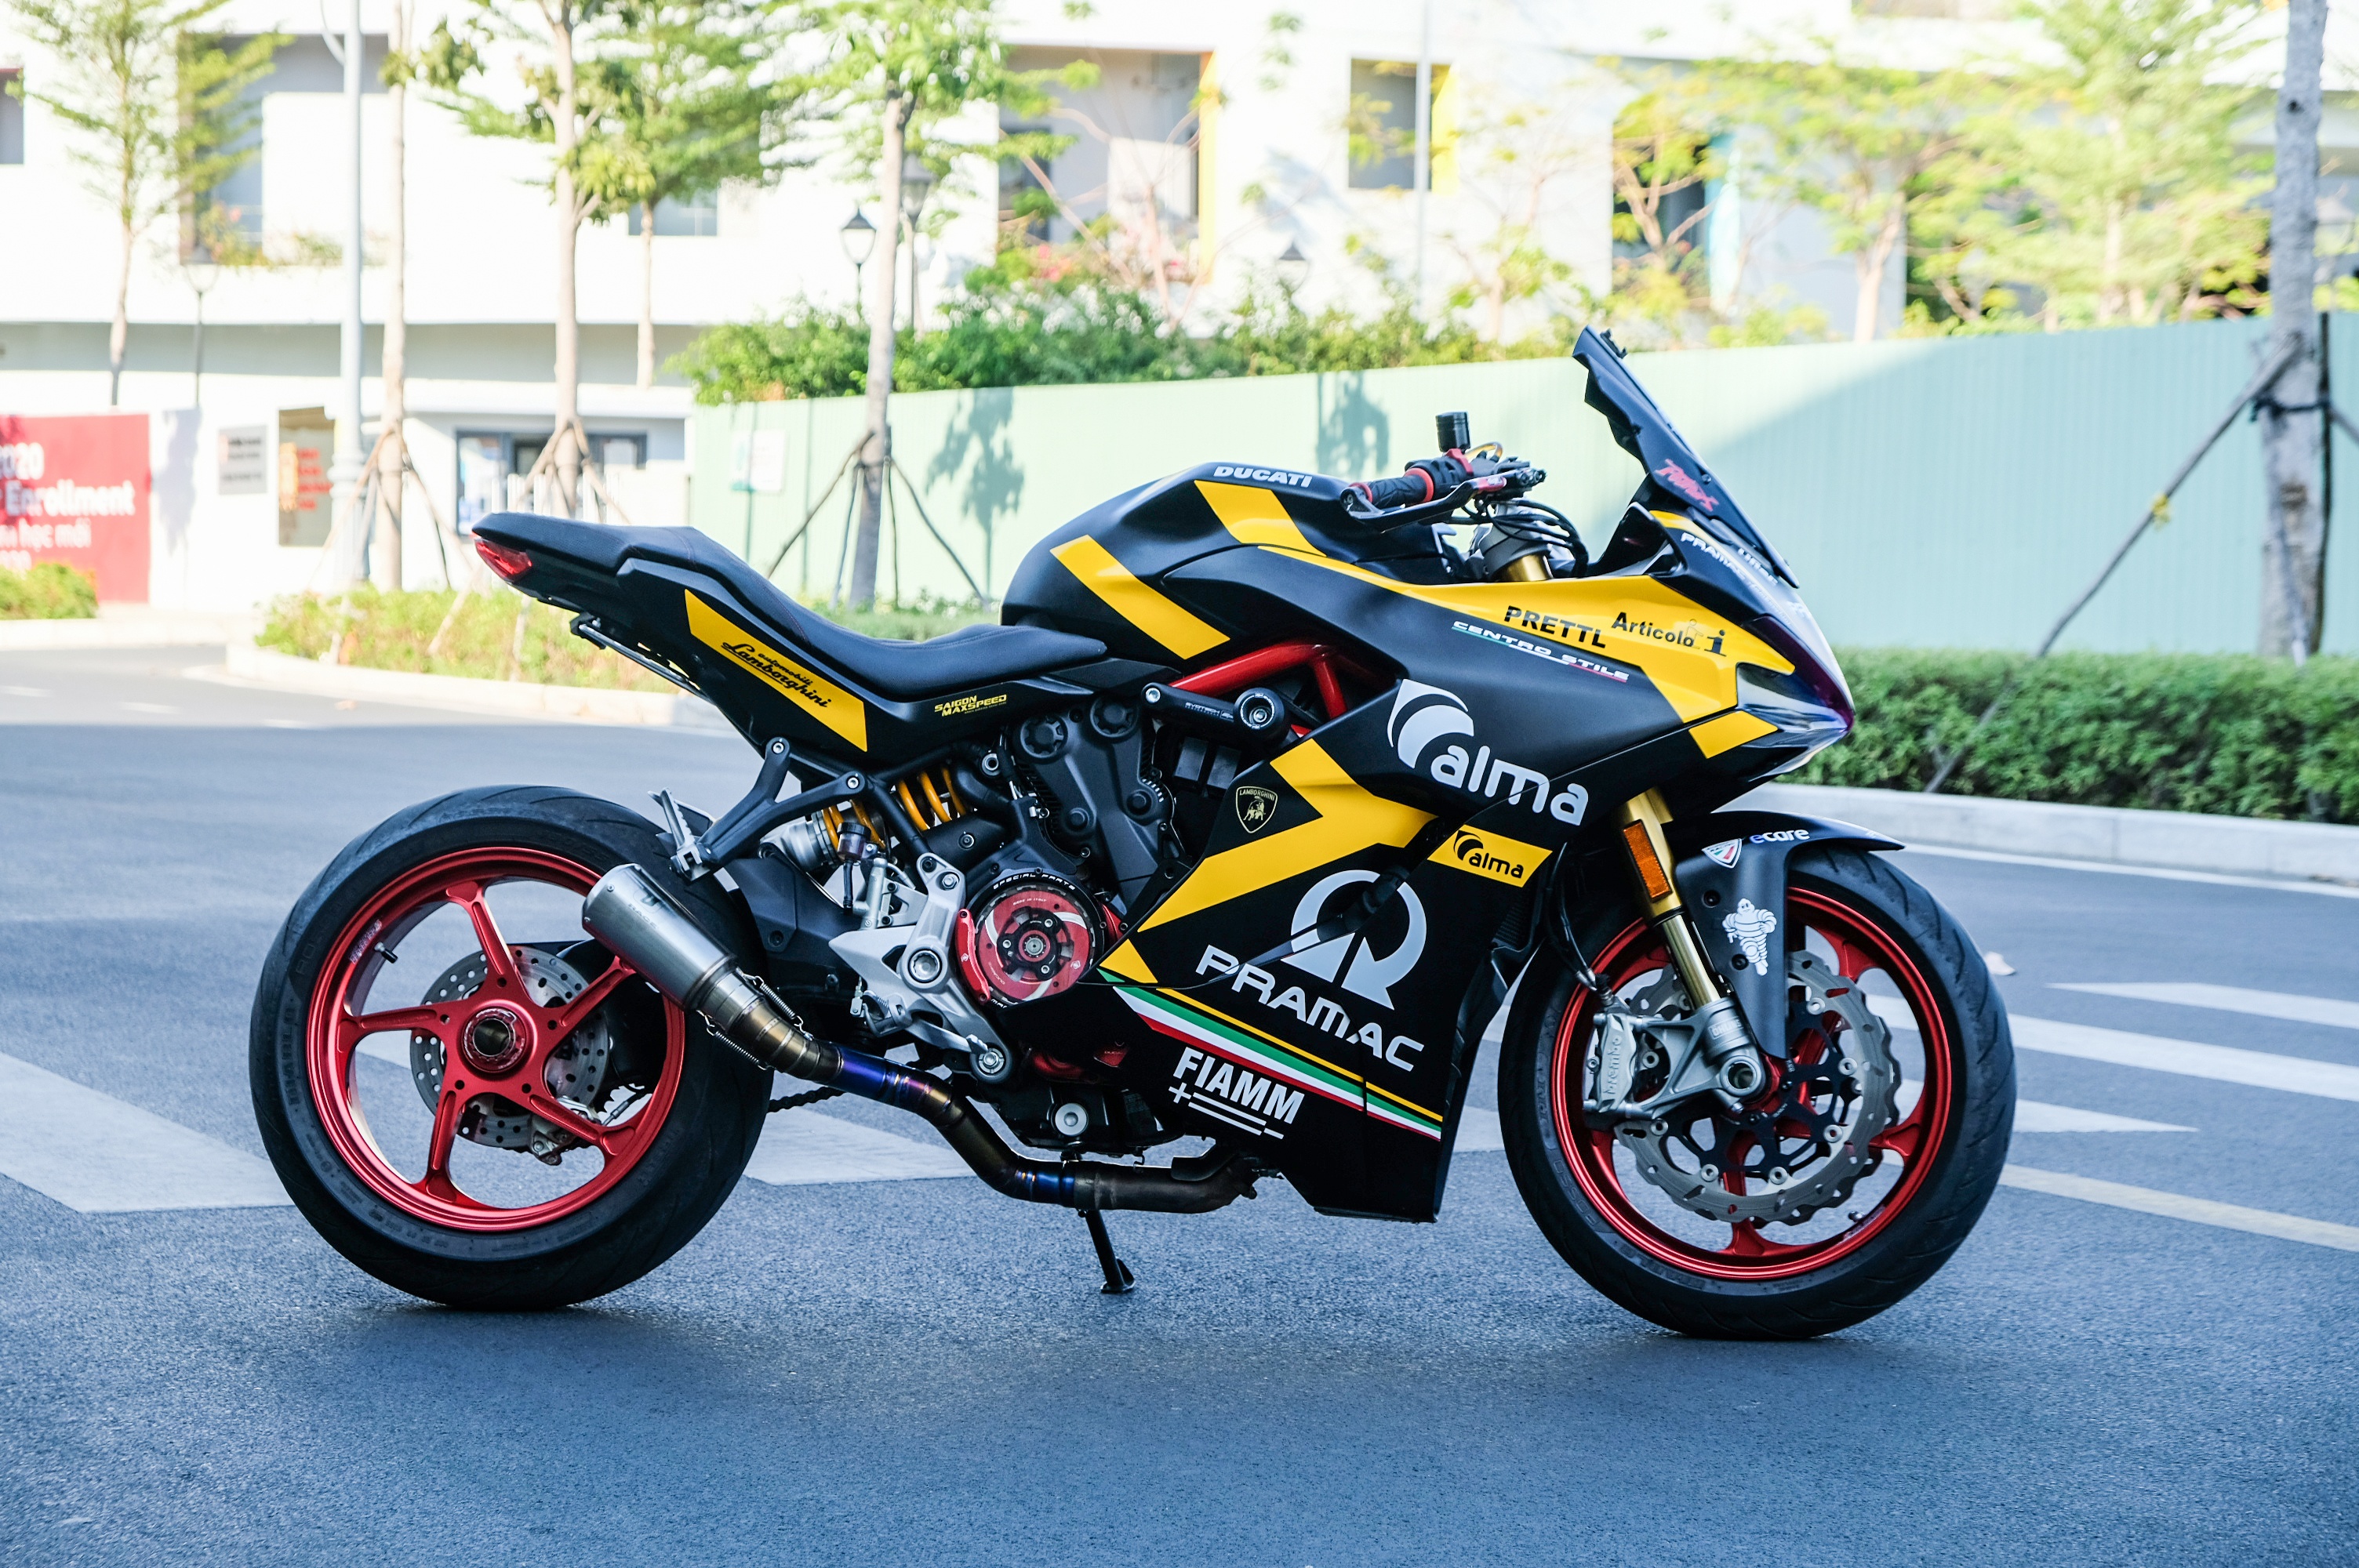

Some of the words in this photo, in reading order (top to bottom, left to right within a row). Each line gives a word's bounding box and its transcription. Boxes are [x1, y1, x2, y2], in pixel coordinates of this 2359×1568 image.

[1213, 466, 1313, 488] DUCATI
[5, 479, 136, 517] Enrollment
[1503, 605, 1606, 649] PRETTL
[1612, 612, 1695, 648] Articolo
[1453, 620, 1552, 656] CENTRO
[1561, 653, 1630, 681] STILE
[722, 642, 831, 708] Lamborghini
[758, 652, 813, 686] automobili
[934, 695, 977, 713] SAIGON
[941, 694, 1007, 717] MAXSPEED
[1239, 789, 1275, 801] LAMBORGHINI
[1430, 744, 1589, 826] alma
[1749, 829, 1810, 844] ecare
[993, 873, 1036, 890] SPECIAL
[1041, 873, 1076, 891] PARTS
[1468, 851, 1525, 879] alma
[1195, 944, 1425, 1072] PRAMAC
[1172, 1046, 1305, 1124] FIAMM
